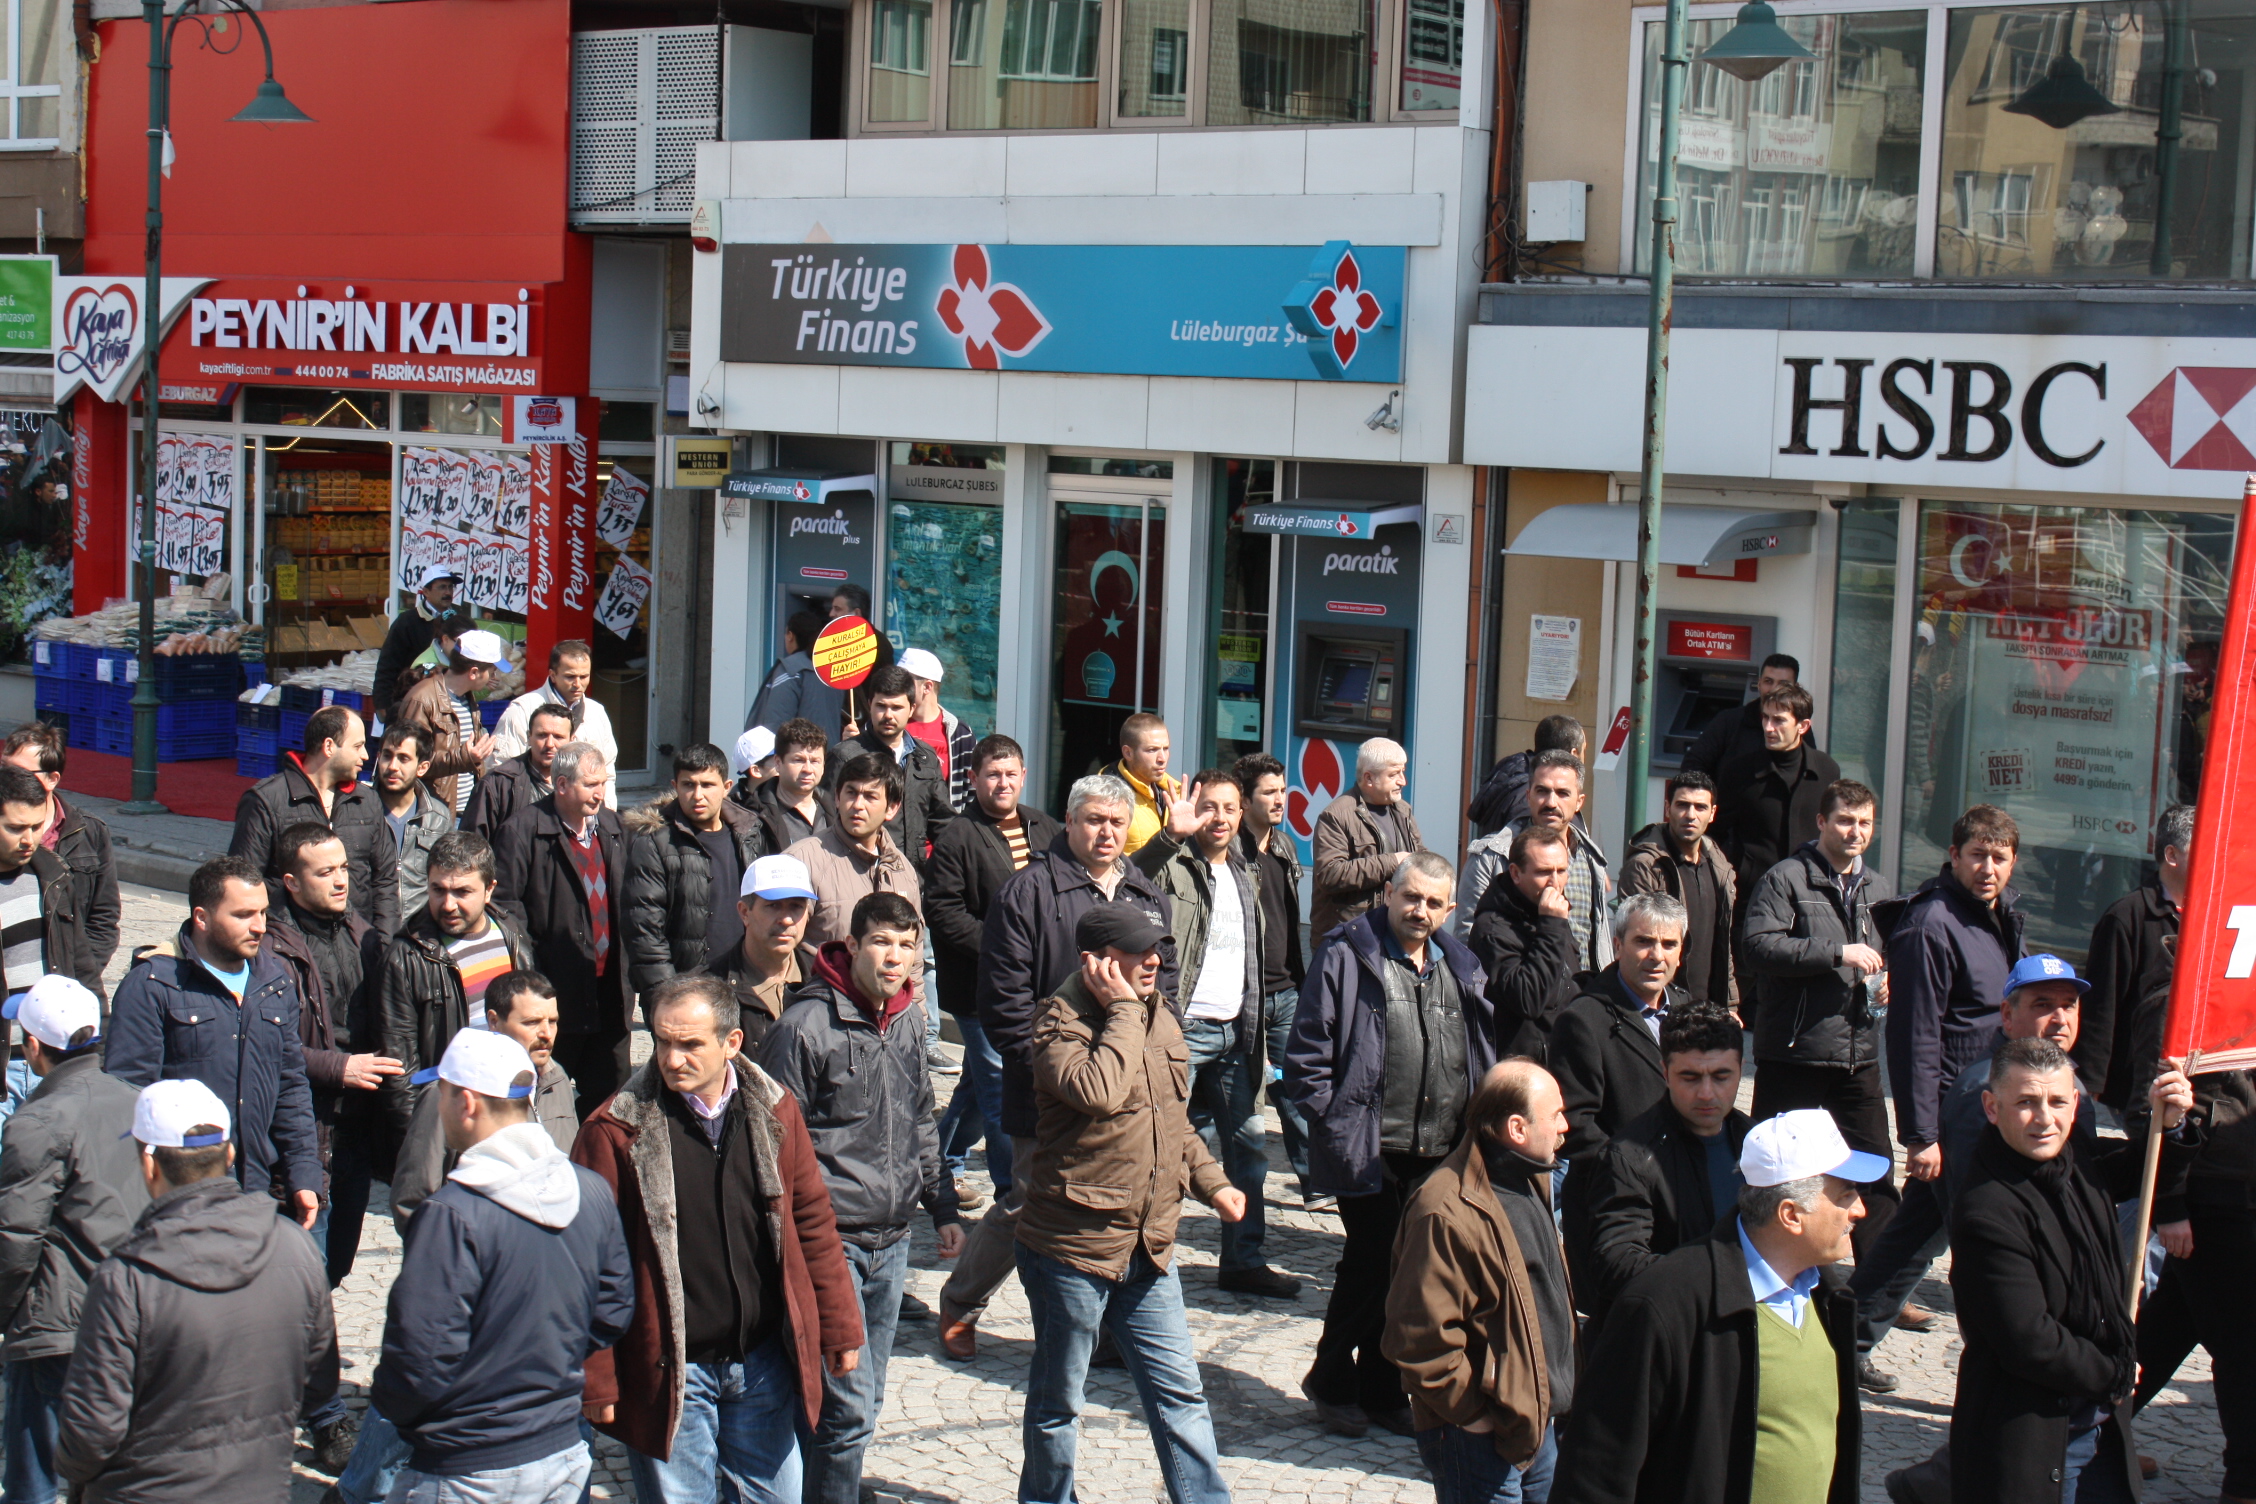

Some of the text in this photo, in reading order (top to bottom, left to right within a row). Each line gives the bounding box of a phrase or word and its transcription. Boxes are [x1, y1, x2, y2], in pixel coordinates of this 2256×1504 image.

[769, 255, 908, 312] Türkiye
[74, 300, 126, 345] Kaya
[191, 285, 528, 357] PEYNİR'İN KALBİ
[796, 310, 919, 356] Finans
[1170, 318, 1279, 348] Lüleburgaz
[200, 361, 272, 377] kayaciftligi.com.tr
[371, 361, 425, 382] FABRİKA
[427, 367, 464, 388] SATIŞ
[465, 363, 536, 387] MAĞAZASI
[1778, 357, 2108, 469] HSBC
[680, 453, 719, 462] WESTERN
[691, 461, 719, 469] UNION
[729, 480, 792, 495] Türkiye Finans
[74, 495, 92, 551] Kaya
[790, 509, 850, 538] paratik
[1252, 513, 1334, 531] Türkiye Finans
[842, 535, 860, 546] plus
[1741, 536, 1766, 553] HSBC
[1322, 544, 1400, 577] paratik
[831, 626, 865, 645] KURALSIZ
[1684, 628, 1735, 641] Bütün Kartların
[828, 642, 866, 663] ÇALIŞMAYA
[1687, 639, 1732, 651] Ortak ATM'si
[2039, 645, 2089, 660] SONRADAN
[2090, 650, 2129, 662] ARTMAZ
[832, 658, 861, 675] HAYIR!
[2014, 686, 2043, 699] Üstelik
[2064, 690, 2075, 701] bir
[2012, 700, 2113, 723] dosya masrafsız!
[2056, 741, 2134, 761] Başvurmak için
[2055, 757, 2117, 775] KREDİ yazın,
[1988, 768, 2024, 786] NET
[2087, 776, 2134, 792] gönderin.
[2072, 814, 2113, 833] HSBC
